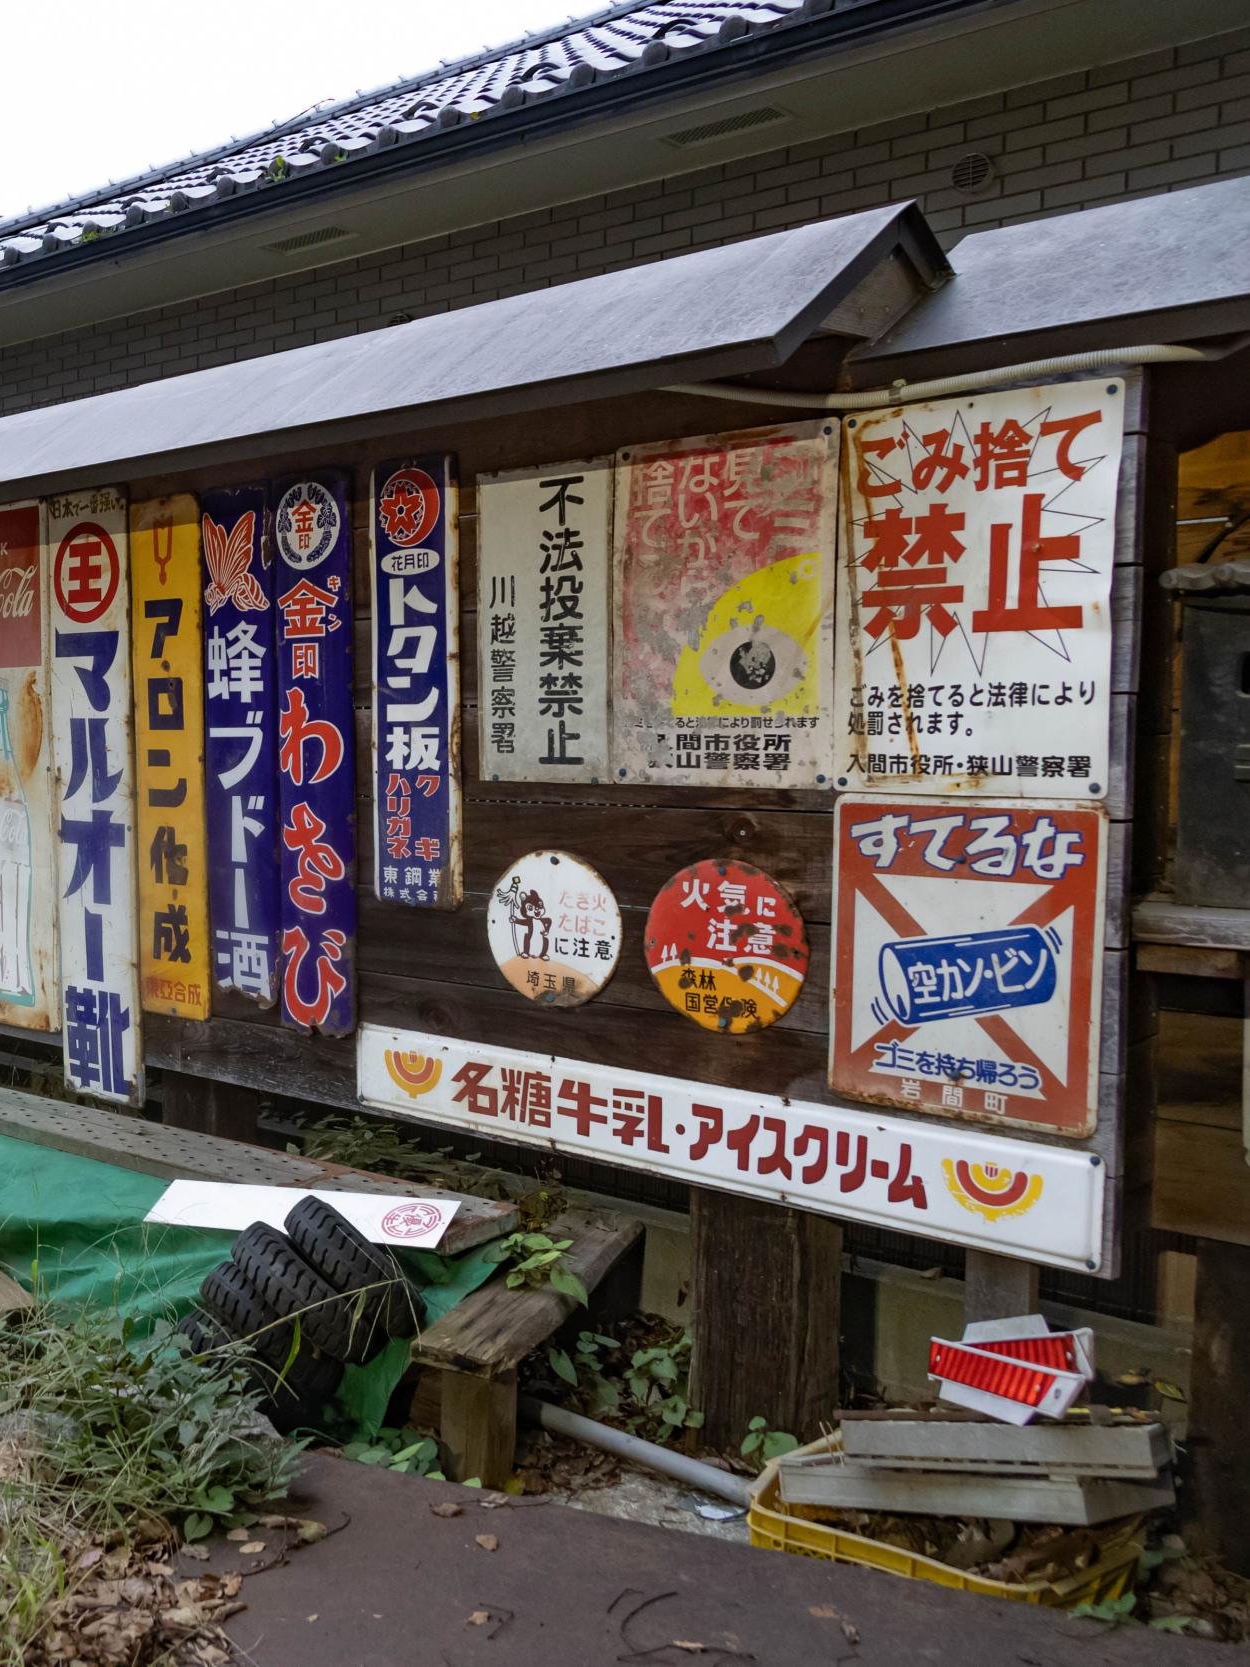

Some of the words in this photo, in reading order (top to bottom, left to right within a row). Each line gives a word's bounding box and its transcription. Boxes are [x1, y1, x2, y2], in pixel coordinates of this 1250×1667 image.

[856, 410, 1102, 498] ごみ捨て
[292, 499, 317, 549] 金印
[391, 552, 429, 572] 花月印
[861, 493, 1084, 640] 禁止
[539, 476, 585, 764] 不法投棄禁止
[385, 578, 441, 772] トタン板
[490, 575, 517, 753] 川越警察署
[849, 681, 1095, 708] ごみを捨てると法律により
[657, 733, 792, 752] 間市役所
[847, 711, 973, 737] 処罰されます。
[144, 598, 191, 963] アロン化成
[648, 752, 792, 770] 山警察署
[846, 754, 1092, 778] 入間市役所・狭山警察署
[277, 578, 346, 1027] 金印わさび
[385, 773, 412, 859] ハリガネ
[55, 627, 130, 1095] マルオー靴
[851, 813, 1086, 880] すてるな
[680, 879, 777, 917] 火気に
[555, 937, 612, 960] に注意
[706, 917, 777, 954] 注意
[526, 970, 576, 993] 埼玉県
[908, 948, 1048, 1004] 空カン・ビン
[874, 1041, 1041, 1090] ゴミを持ち帰ろう
[901, 1078, 1008, 1115] 岩間町
[451, 1061, 928, 1209] 名糖牛乳・アイスクリーム
